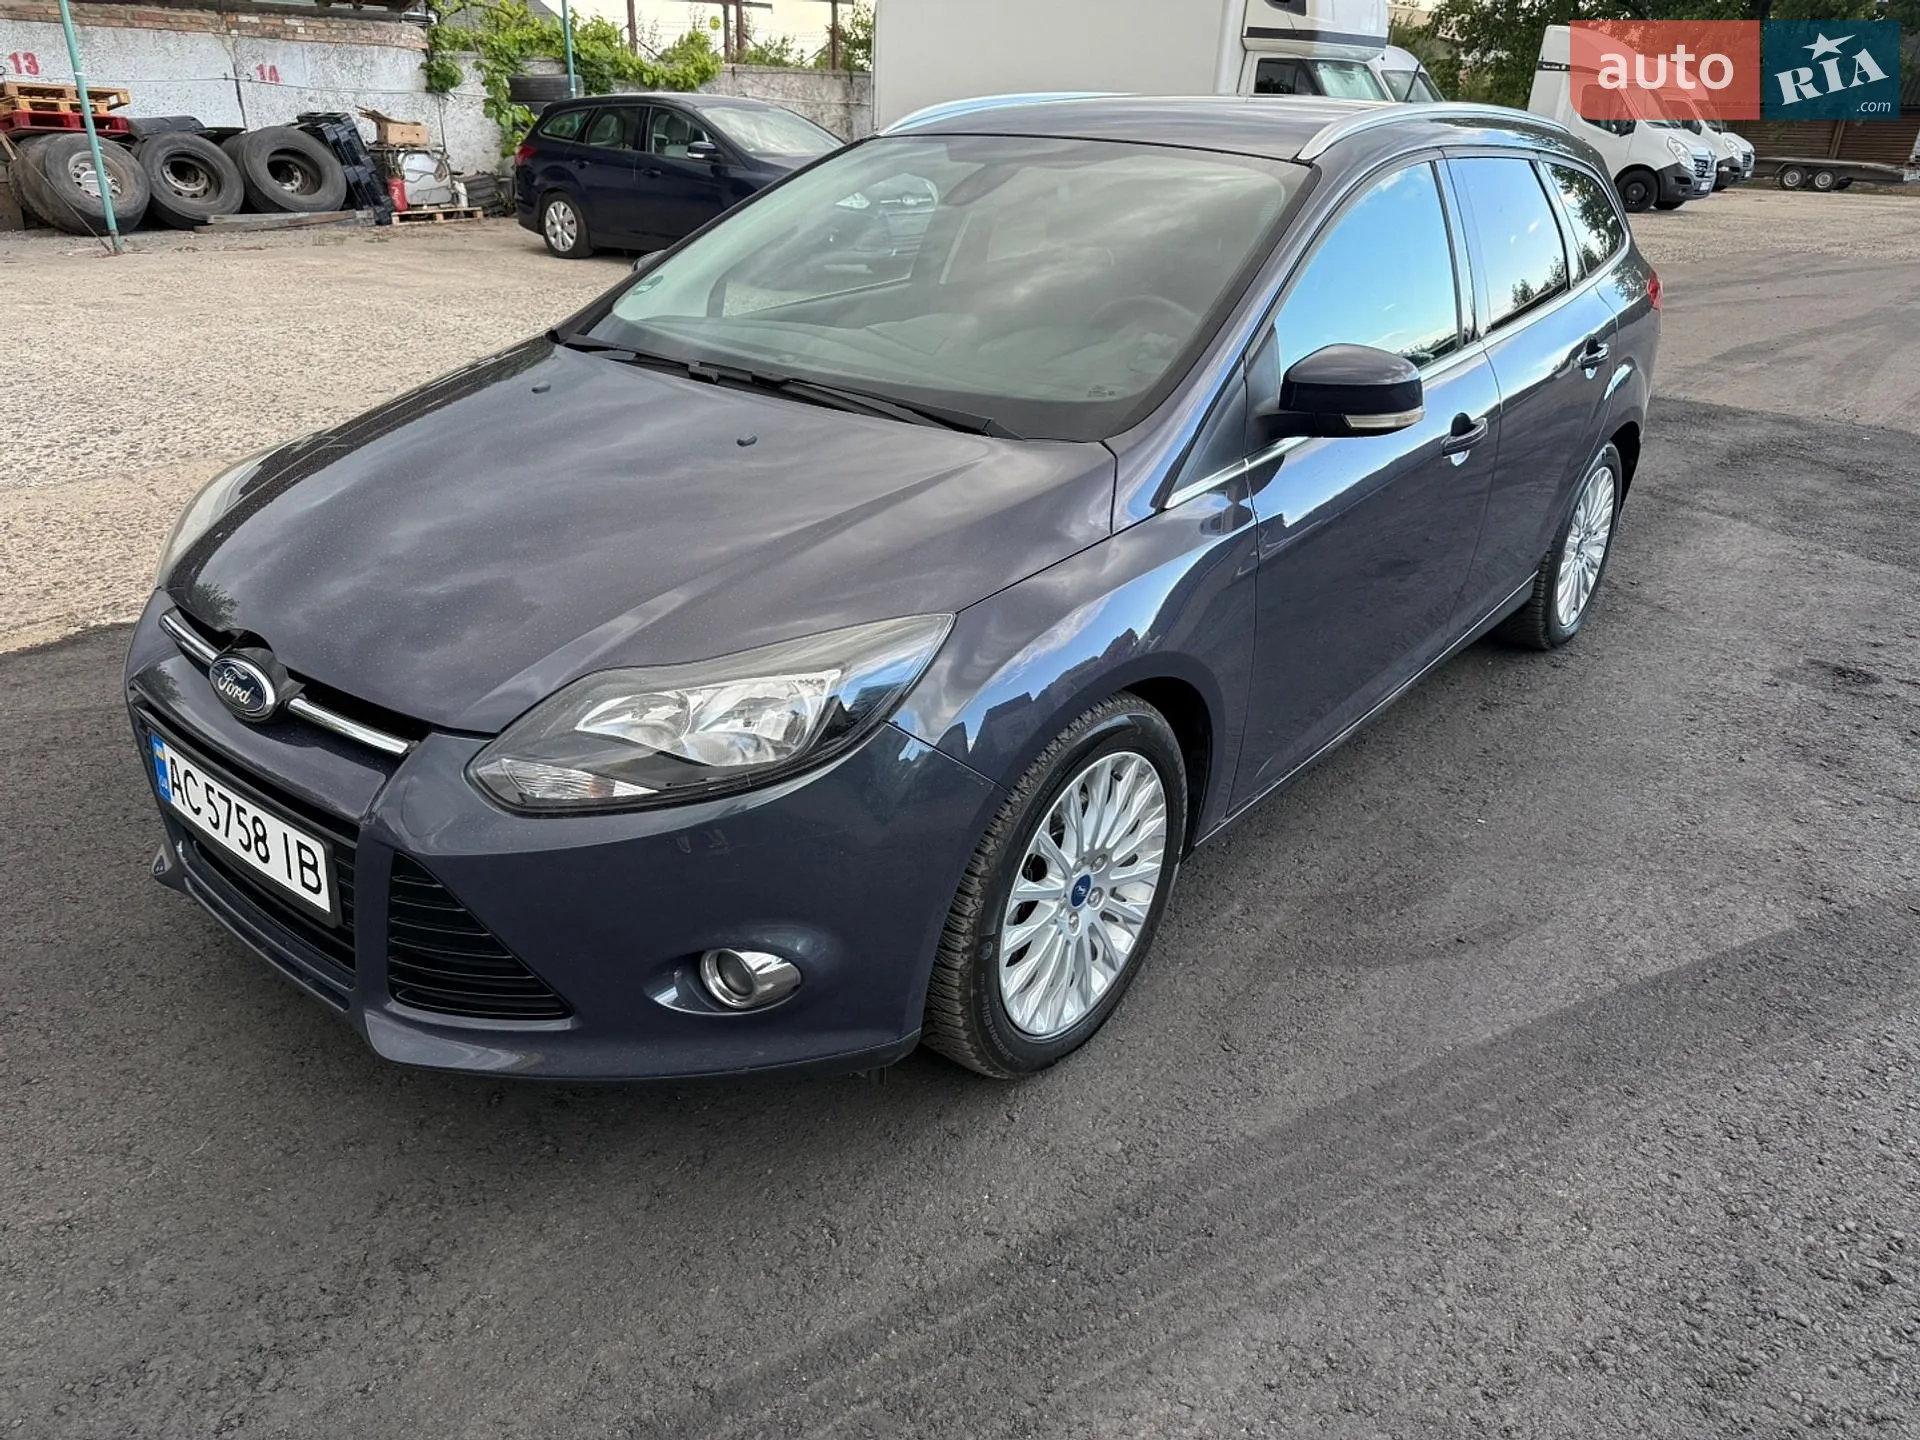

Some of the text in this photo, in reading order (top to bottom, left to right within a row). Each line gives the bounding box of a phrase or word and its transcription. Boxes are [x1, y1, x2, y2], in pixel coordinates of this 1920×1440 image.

[8, 52, 40, 76] 13
[255, 63, 282, 83] 14
[217, 666, 256, 705] Ford
[169, 756, 323, 895] AC 5758 IB
